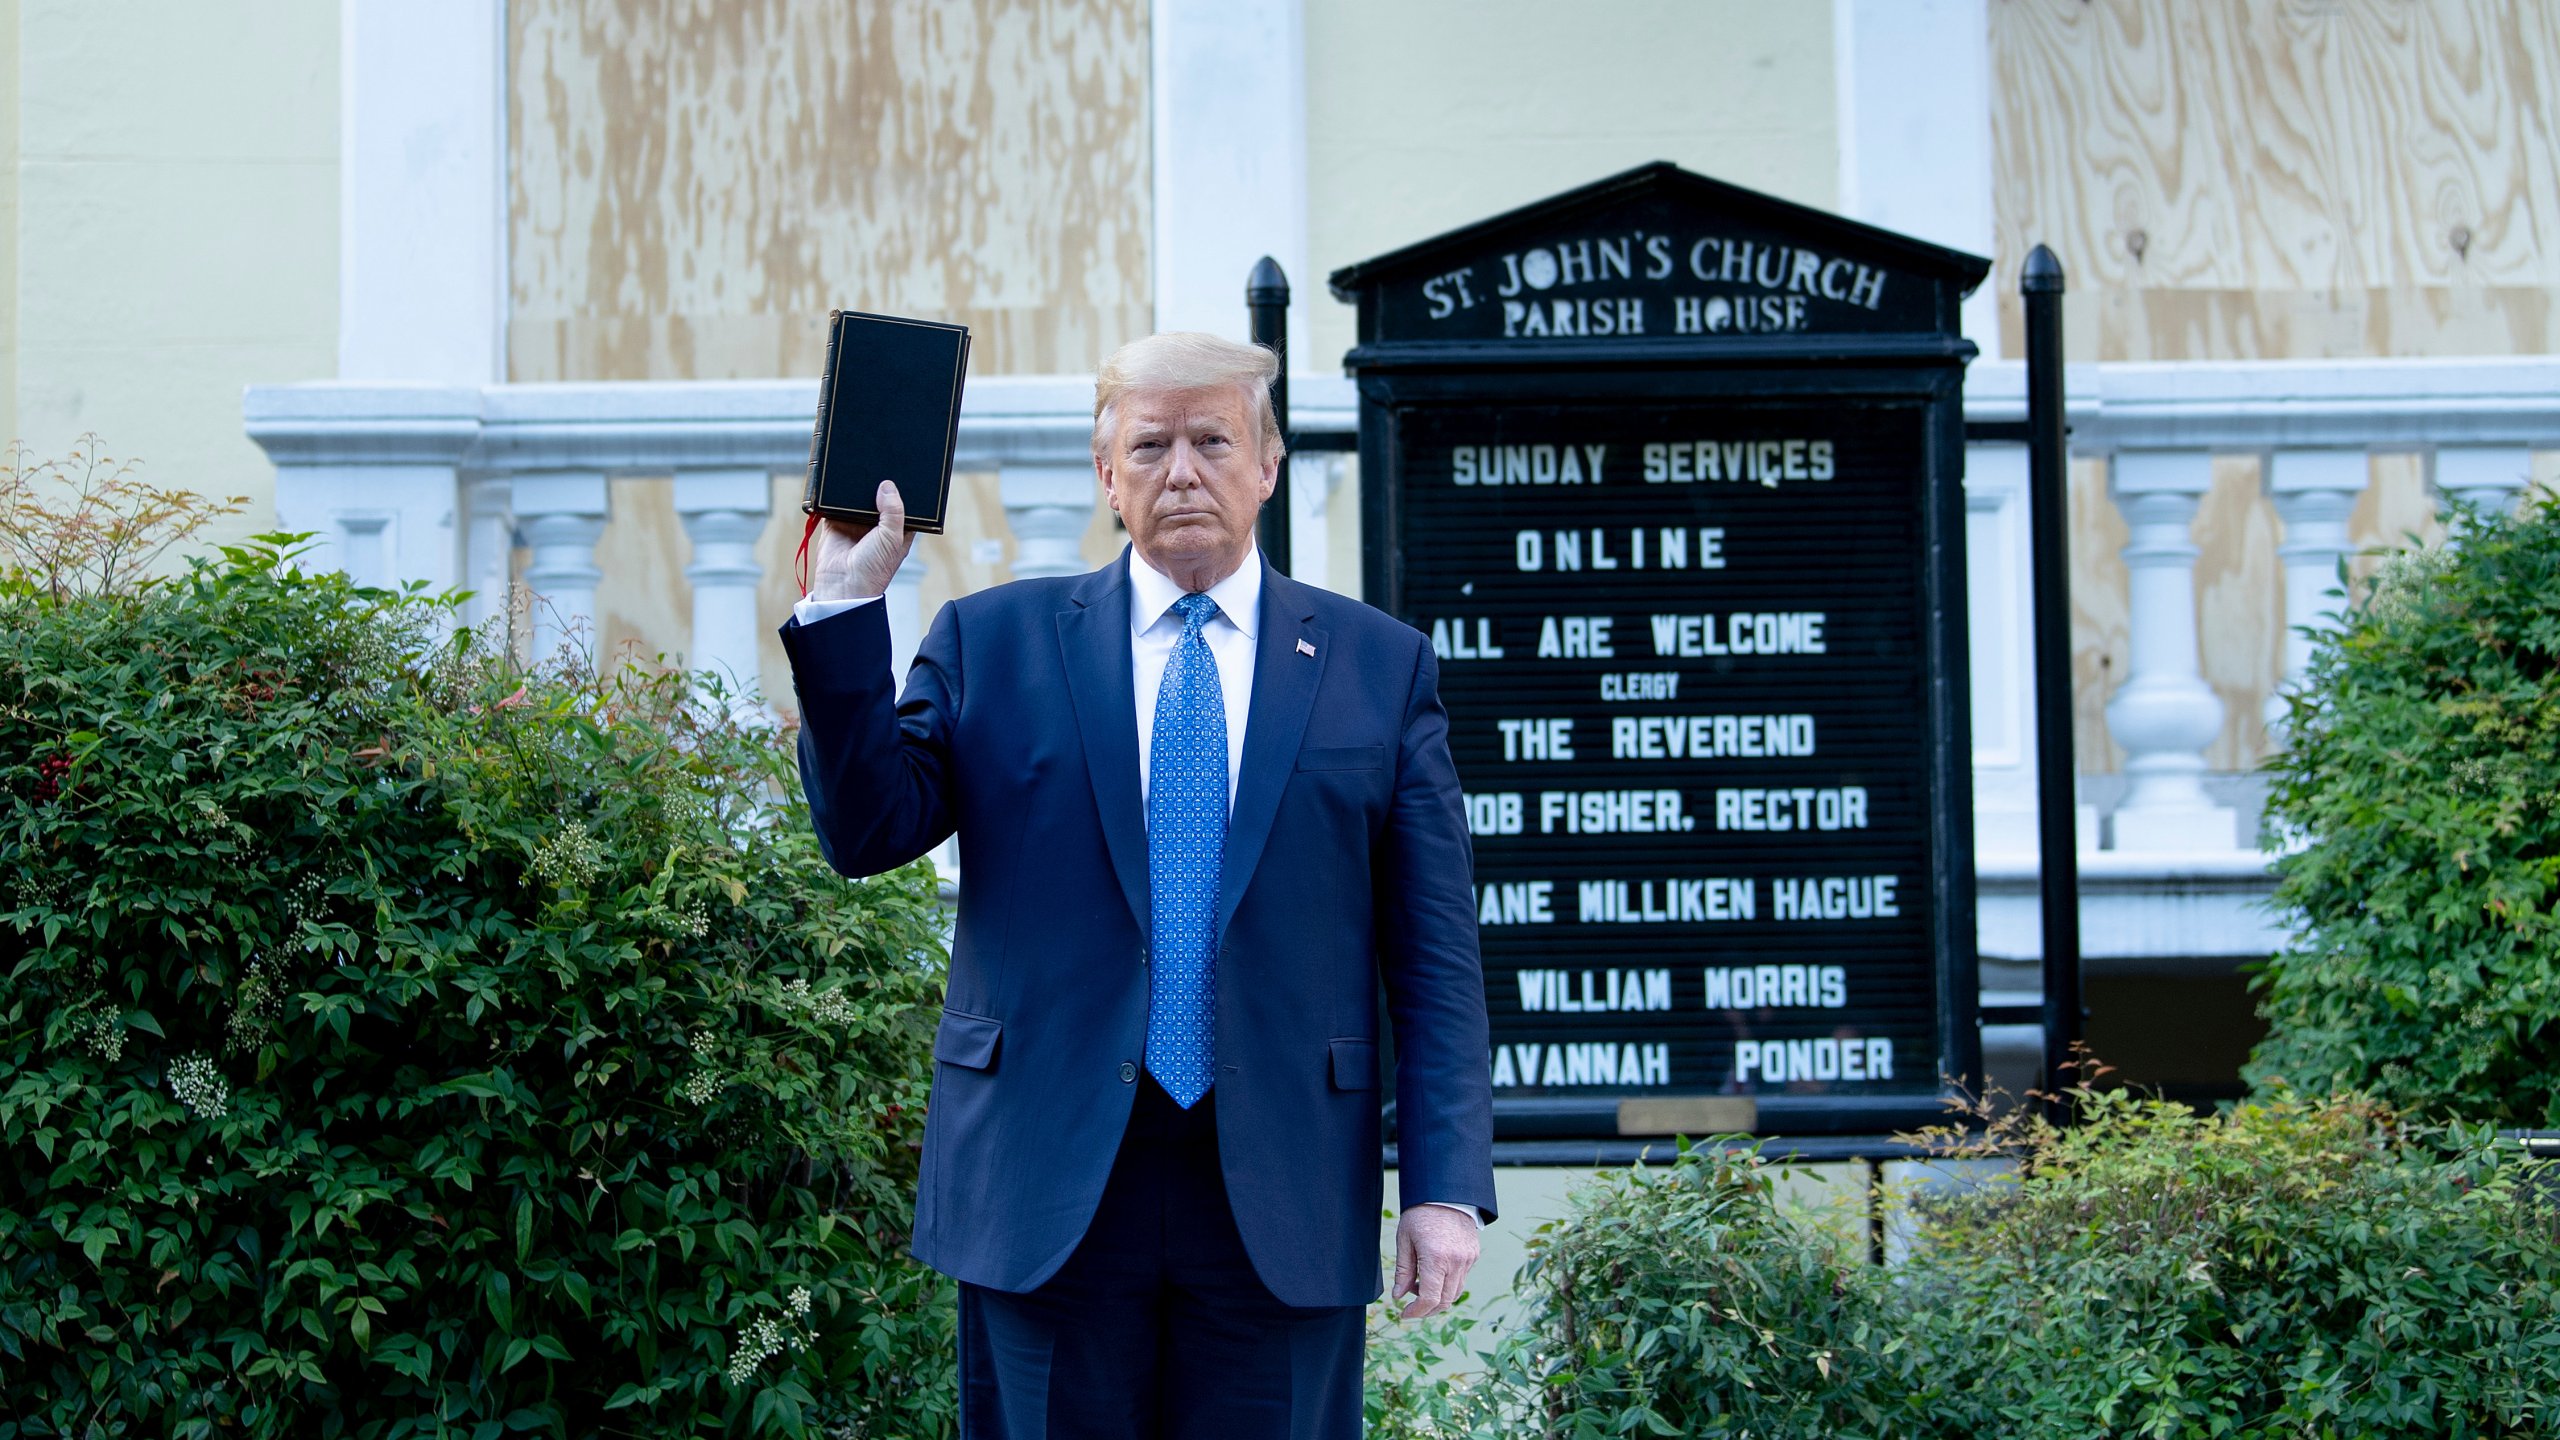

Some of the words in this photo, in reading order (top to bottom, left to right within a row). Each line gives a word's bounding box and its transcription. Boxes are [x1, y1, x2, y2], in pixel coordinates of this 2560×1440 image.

[1423, 268, 1484, 319] ST.
[1498, 233, 1673, 297] JOHN'S
[1690, 238, 1887, 309] CHURCH
[1503, 299, 1644, 337] PARISH
[1675, 295, 1808, 334] HOUSE
[1453, 446, 1604, 485] SUNDAY
[1644, 441, 1834, 483] SERVICES
[1516, 527, 1726, 571] ONLINE
[1431, 617, 1504, 660] ALL
[1537, 616, 1614, 658] ARE
[1650, 612, 1826, 657] WELCOME
[1600, 672, 1679, 701] CLERGY
[1498, 718, 1575, 762] THE
[1612, 714, 1815, 759] REVEREND
[1716, 786, 1868, 831] RECTOR
[1472, 881, 1555, 925] ANE
[1579, 878, 1755, 923] MILLIKEN
[1773, 875, 1899, 920] HAGUE
[1518, 968, 1671, 1012] WILLIAM
[1704, 964, 1846, 1009] MORRIS
[1489, 1042, 1670, 1087] AVANNAH
[1734, 1037, 1893, 1083] PONDER
